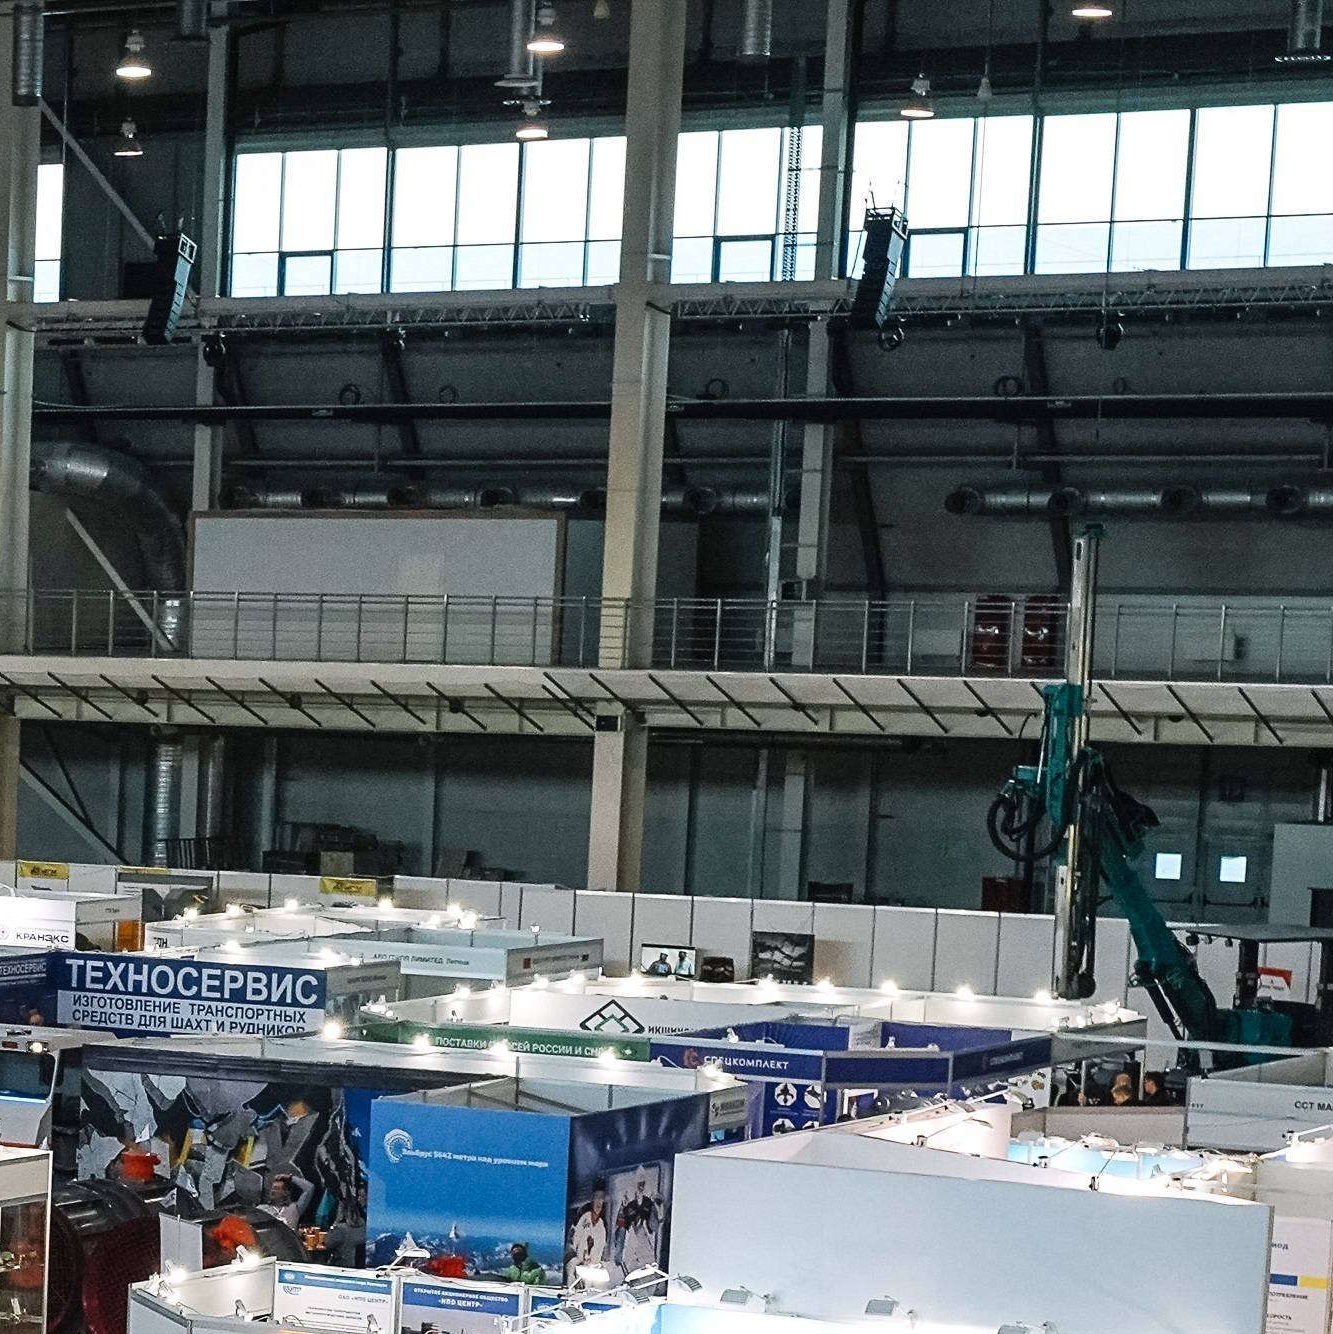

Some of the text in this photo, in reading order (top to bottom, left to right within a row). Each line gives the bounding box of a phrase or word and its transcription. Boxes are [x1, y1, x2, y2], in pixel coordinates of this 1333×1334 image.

[15, 931, 69, 943] КРАНЭКС
[65, 958, 319, 1006] ТЕХНОСЕРВИС
[73, 994, 306, 1024] ИЗГОТОВЛЕНИЕ ТРАНСПОРТНЫХ
[72, 1010, 134, 1026] СРЕДСТВ
[137, 1014, 167, 1030] ДЛЯ
[171, 1016, 212, 1031] ШАХТ
[216, 1022, 225, 1032] И
[435, 1036, 582, 1055] ПОСТАВКИ РОССИИ И
